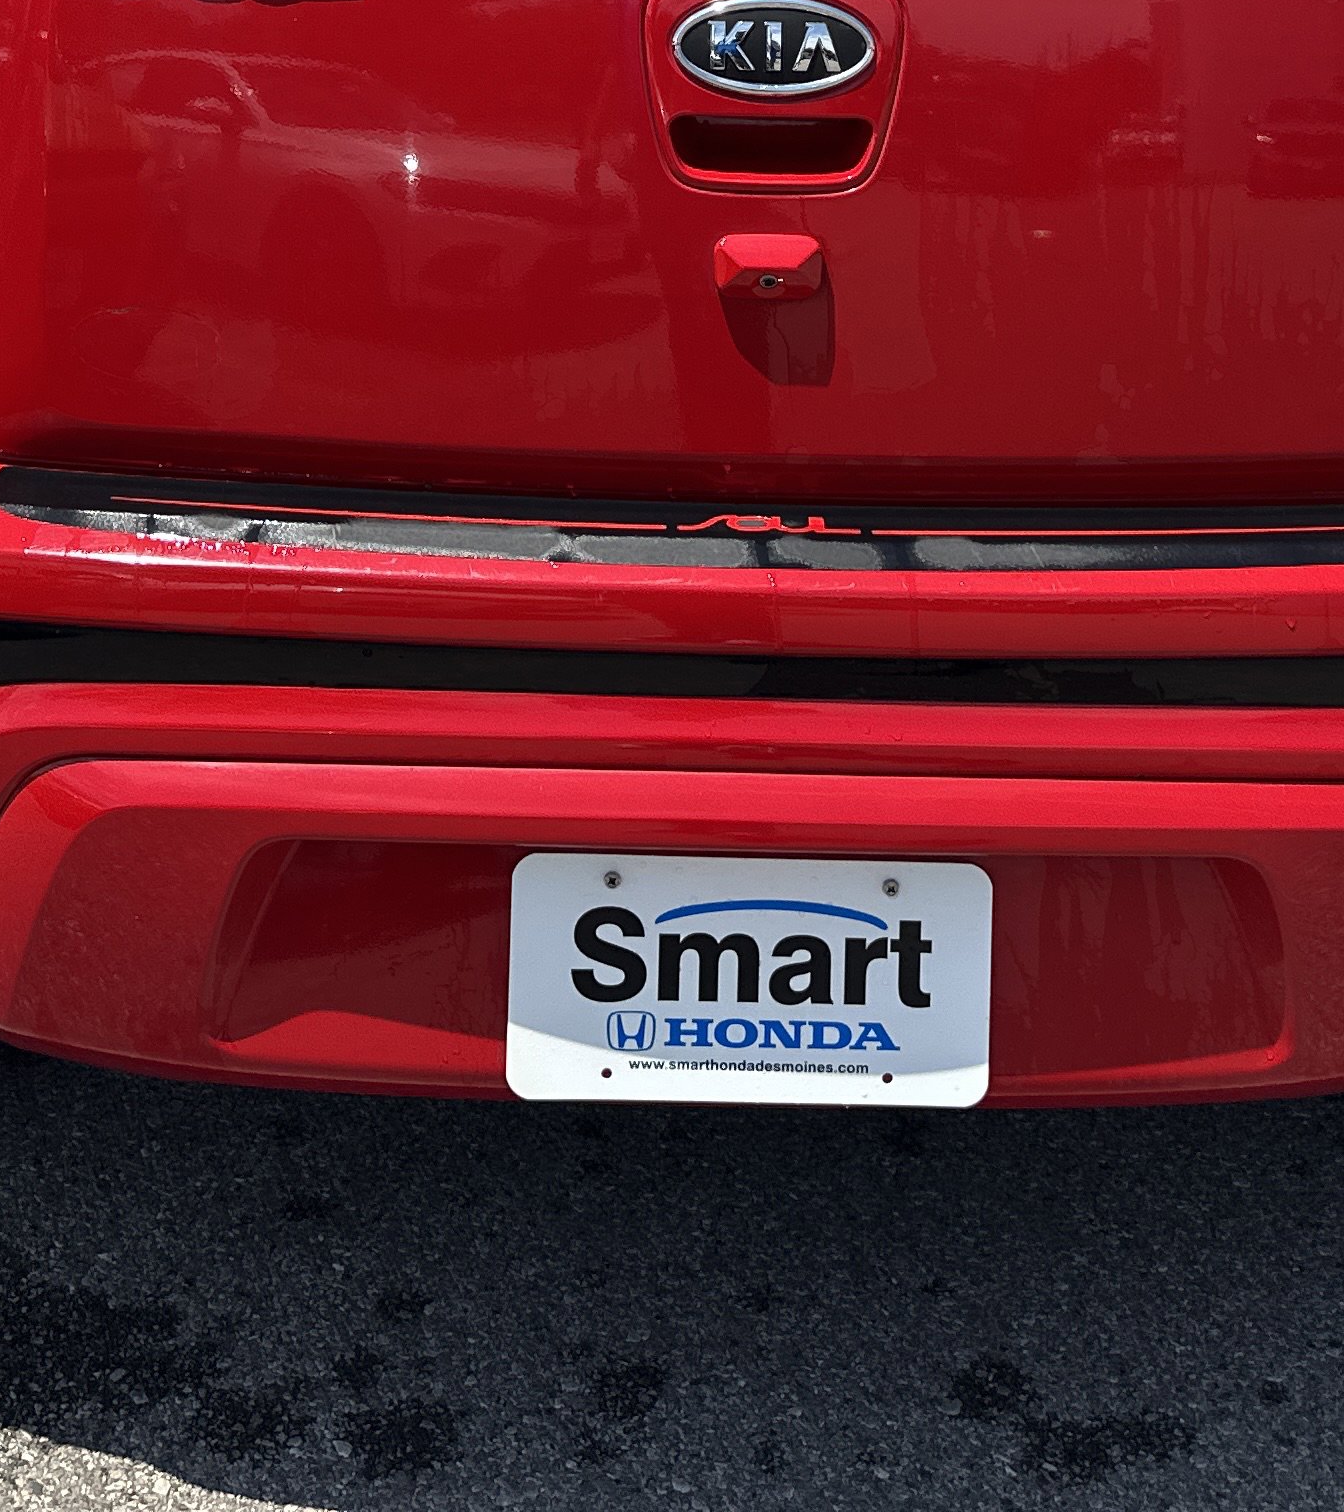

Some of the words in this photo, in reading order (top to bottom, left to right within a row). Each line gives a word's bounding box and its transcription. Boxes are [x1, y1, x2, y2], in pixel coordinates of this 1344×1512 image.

[708, 20, 842, 72] KIA
[570, 905, 933, 1009] Smart
[663, 1017, 901, 1052] HONDA
[628, 1058, 870, 1075] www.smarthondadesmoines.com
